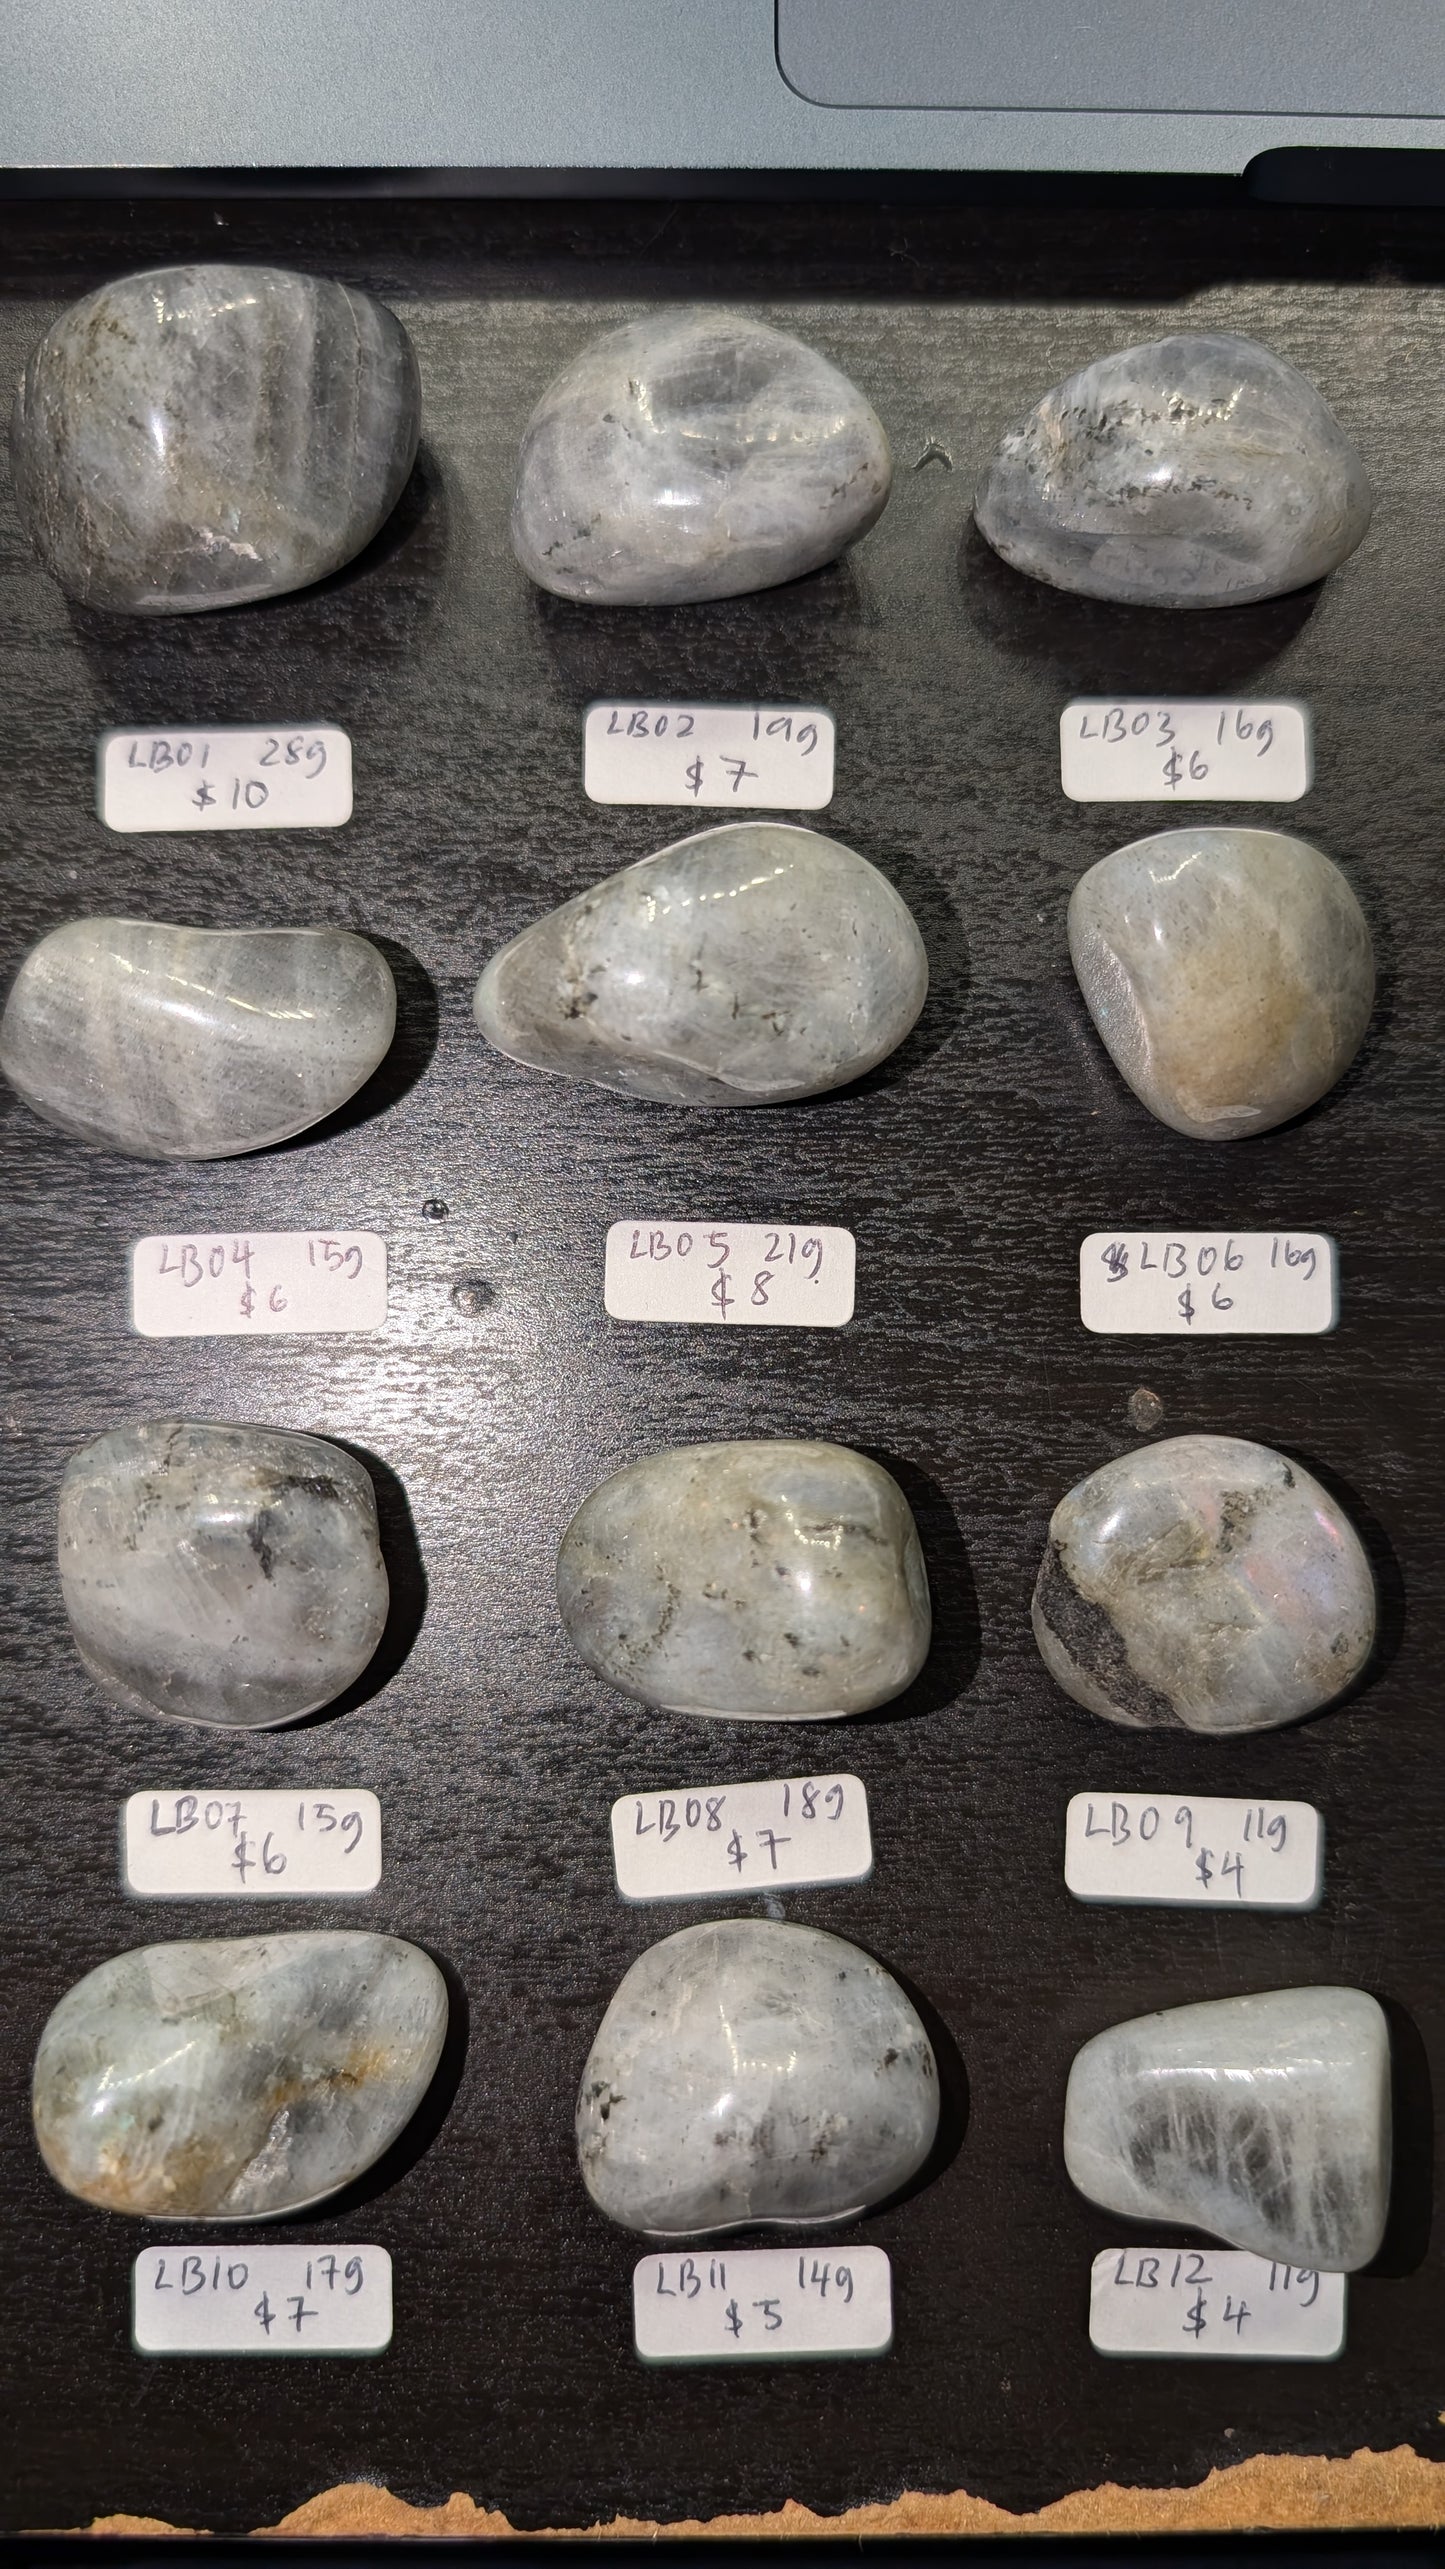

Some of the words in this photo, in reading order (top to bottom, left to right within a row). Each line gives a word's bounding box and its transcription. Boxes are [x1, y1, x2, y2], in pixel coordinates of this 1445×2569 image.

[606, 711, 694, 738] LB02
[1079, 708, 1175, 748] LB03
[127, 740, 208, 773] LB01
[159, 1243, 255, 1288] LB04
[629, 1229, 730, 1269] LB05
[1140, 1239, 1244, 1279] LB06
[150, 1795, 247, 1838] LB07
[635, 1796, 726, 1842] LB08
[1085, 1801, 1192, 1849] LB09
[154, 2256, 249, 2296] LB10
[656, 2258, 726, 2298] LB11
[1114, 2253, 1213, 2288] LB12
